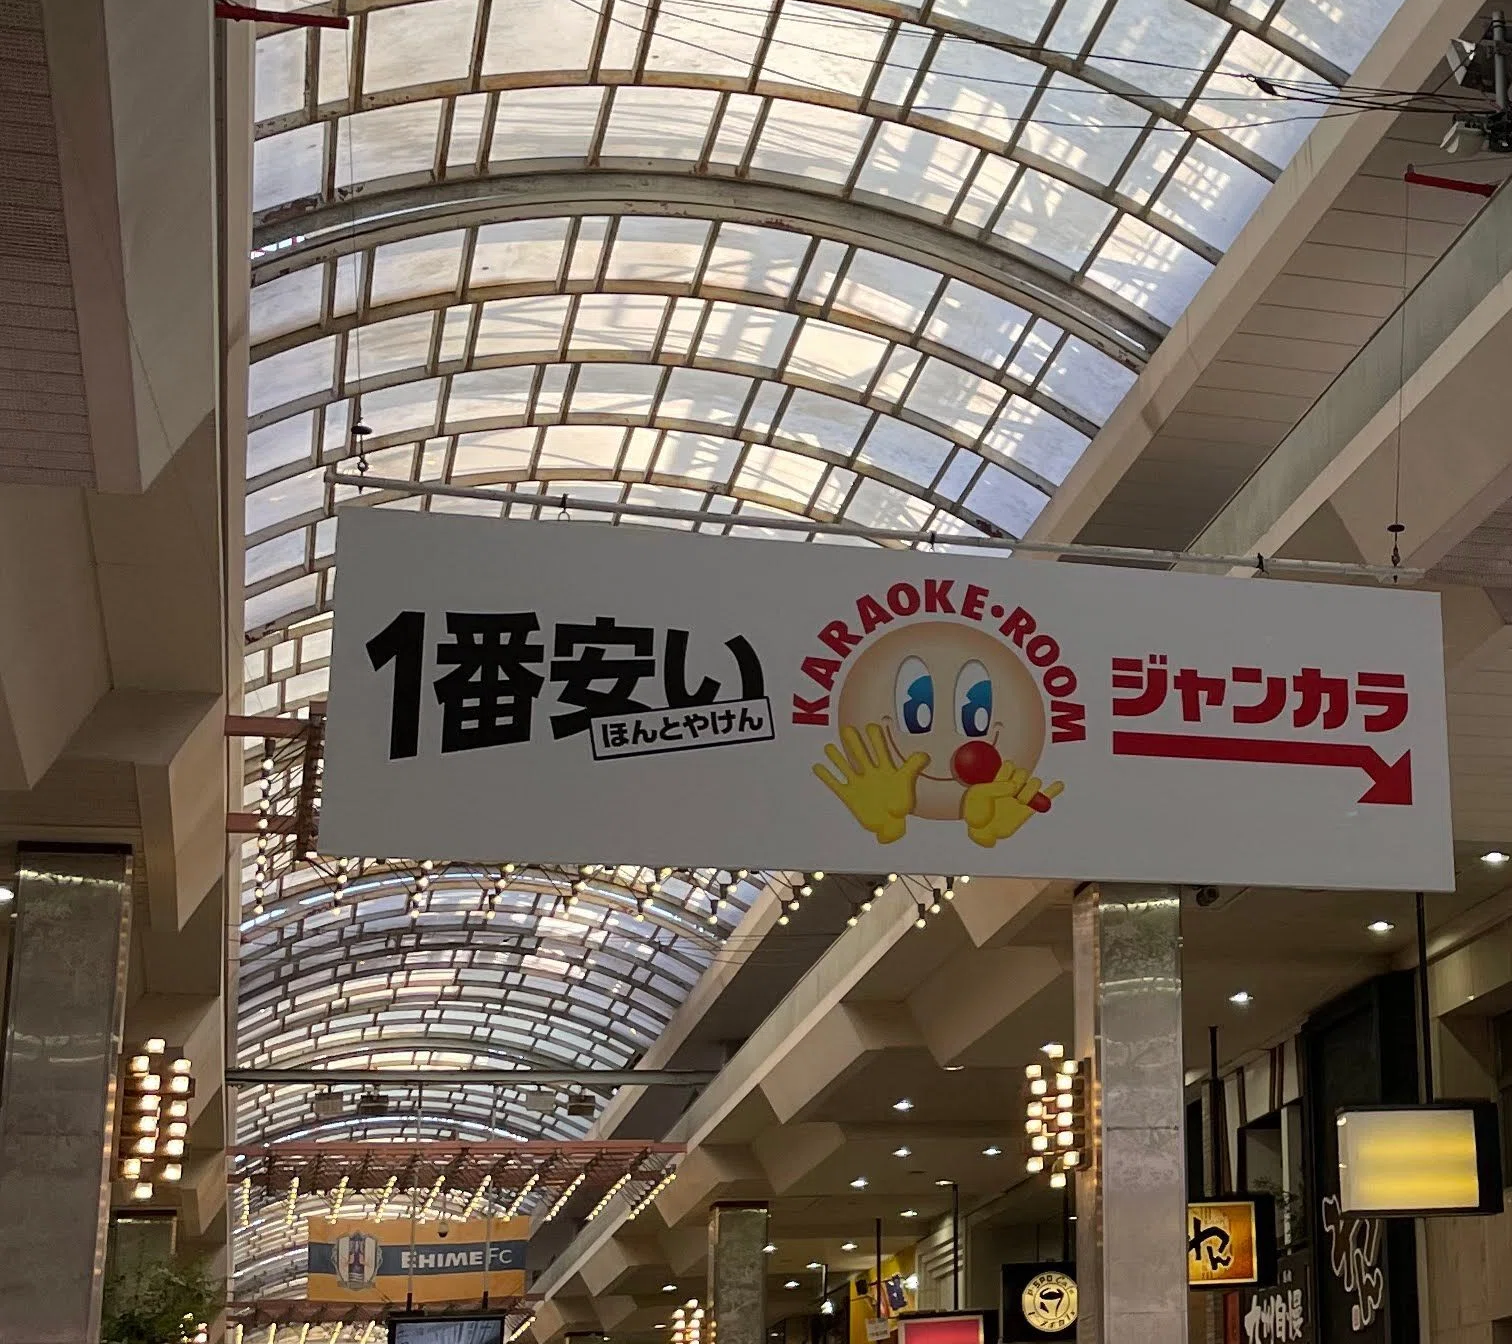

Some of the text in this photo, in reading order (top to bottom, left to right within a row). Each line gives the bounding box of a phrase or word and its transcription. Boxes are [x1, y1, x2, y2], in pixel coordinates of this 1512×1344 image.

[366, 610, 765, 761] 1番安い
[1111, 654, 1411, 734] ジャンカラ
[601, 706, 764, 749] ほんとやけん
[401, 1247, 513, 1270] EHIME FC
